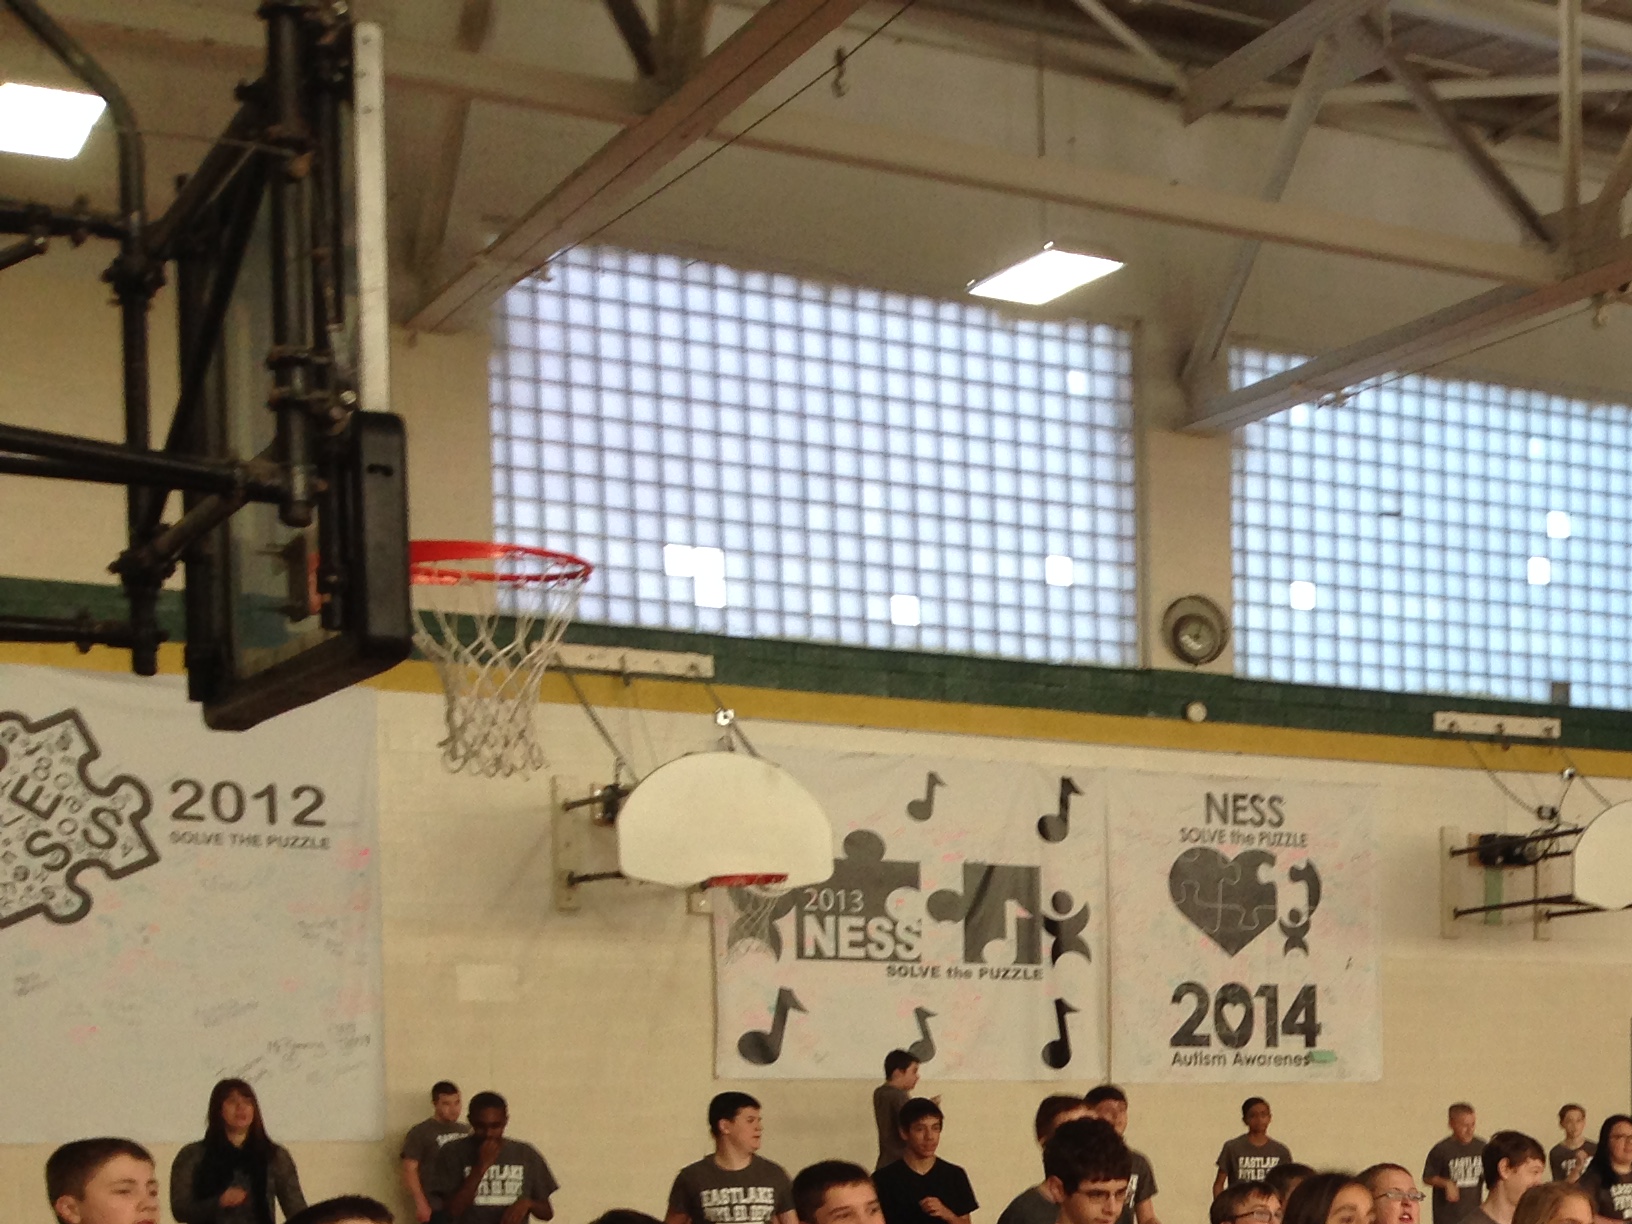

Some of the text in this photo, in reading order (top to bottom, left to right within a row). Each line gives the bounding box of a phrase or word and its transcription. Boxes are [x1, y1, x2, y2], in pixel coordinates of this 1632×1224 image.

[168, 778, 327, 827] 2012
[1204, 792, 1285, 828] NESS
[169, 829, 331, 851] SOLVE THE PUZZLE
[1179, 827, 1308, 849] SOLVE the PUZZLE
[803, 888, 865, 913] 2013
[803, 916, 922, 961] NESS
[886, 964, 1044, 982] SOLVE the PUZZLE
[1168, 981, 1321, 1048] 2014
[1172, 1051, 1312, 1067] Autism Awarenes
[700, 1186, 775, 1208] EASTLAKE
